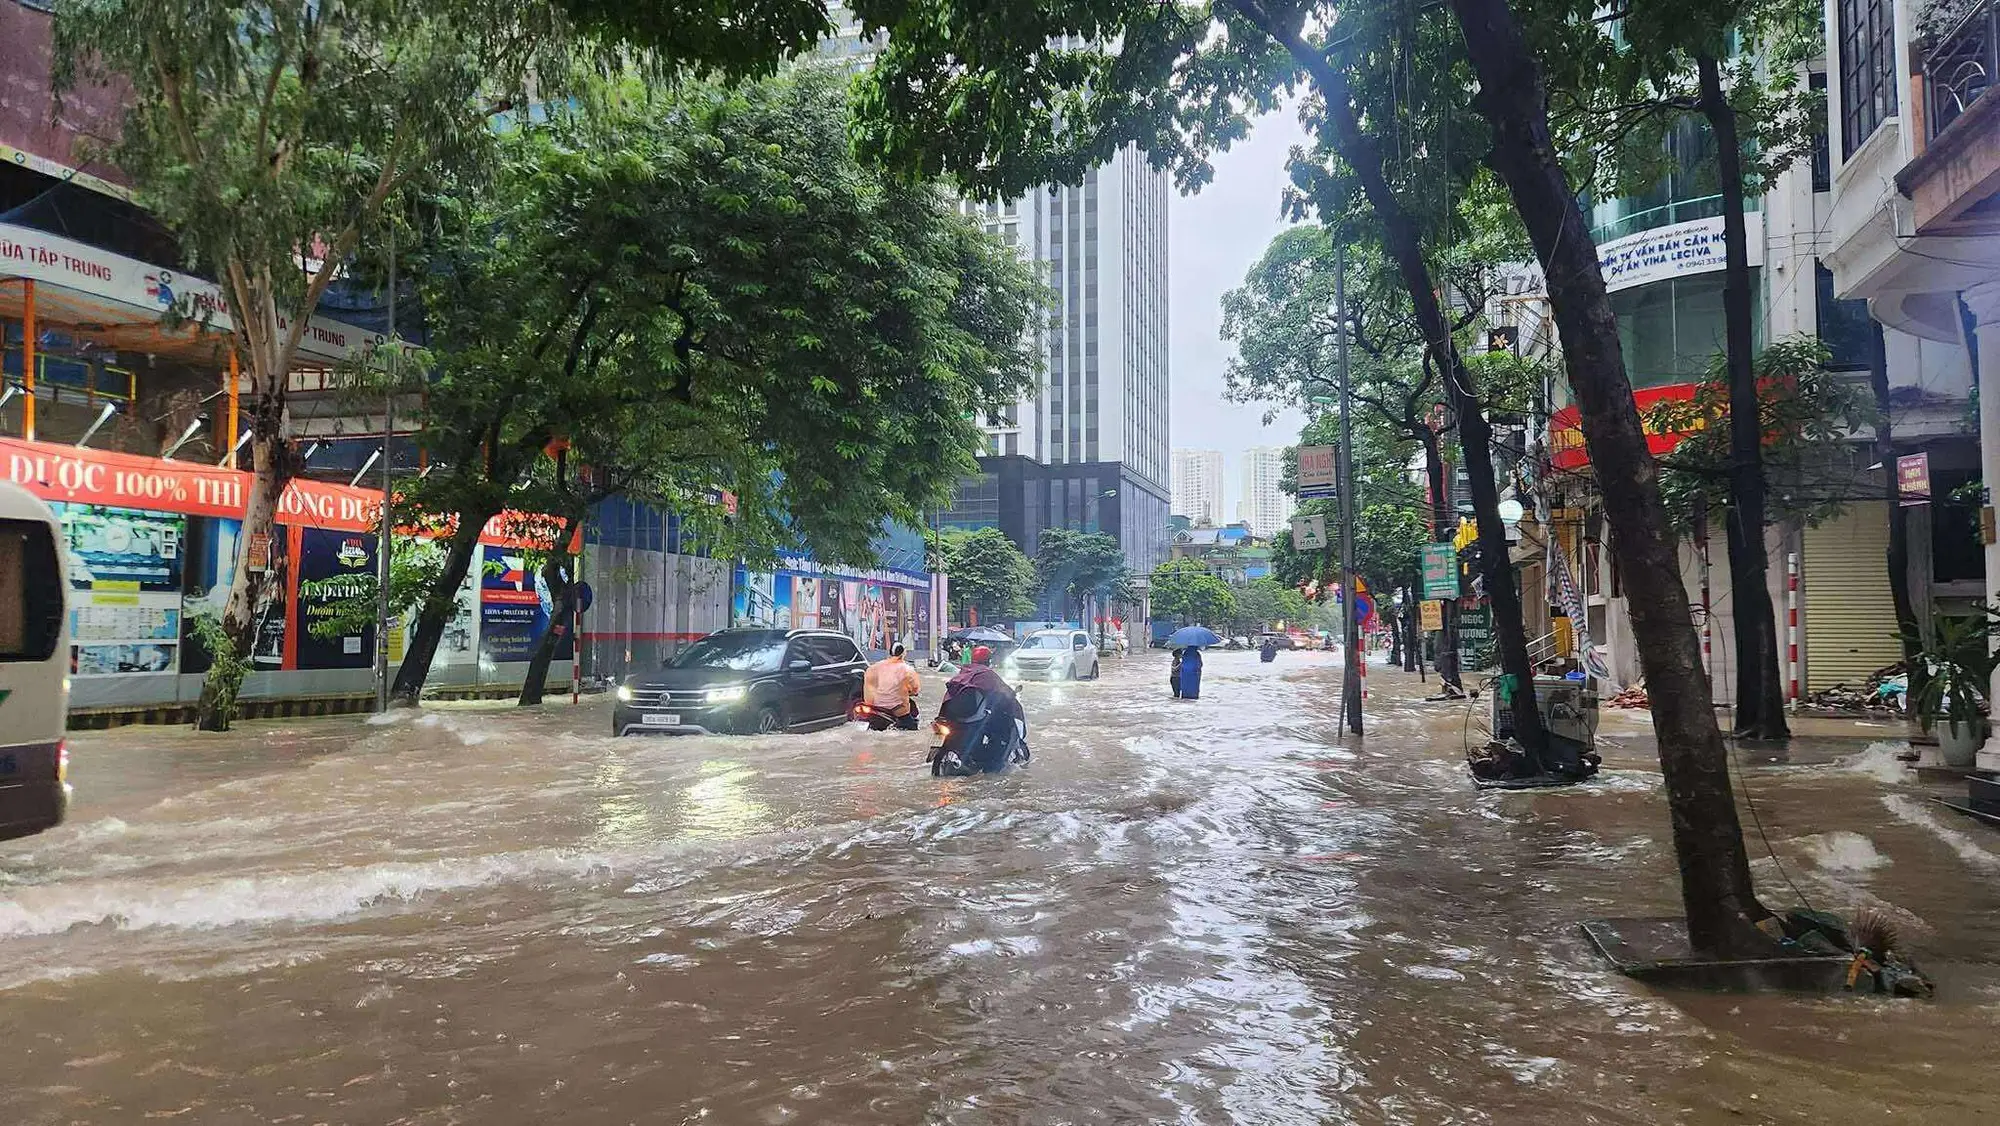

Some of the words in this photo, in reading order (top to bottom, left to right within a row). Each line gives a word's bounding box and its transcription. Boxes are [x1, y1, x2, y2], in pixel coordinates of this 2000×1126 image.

[1658, 236, 1680, 252] BÁN
[1684, 231, 1708, 246] CĂN
[28, 246, 58, 268] TẬP
[62, 255, 112, 282] TRUNG
[1671, 246, 1711, 261] LECIVA
[312, 326, 345, 347] TRUNG
[10, 453, 105, 497] ĐƯỢC
[113, 471, 187, 502] 100%
[193, 475, 242, 508] THÌ
